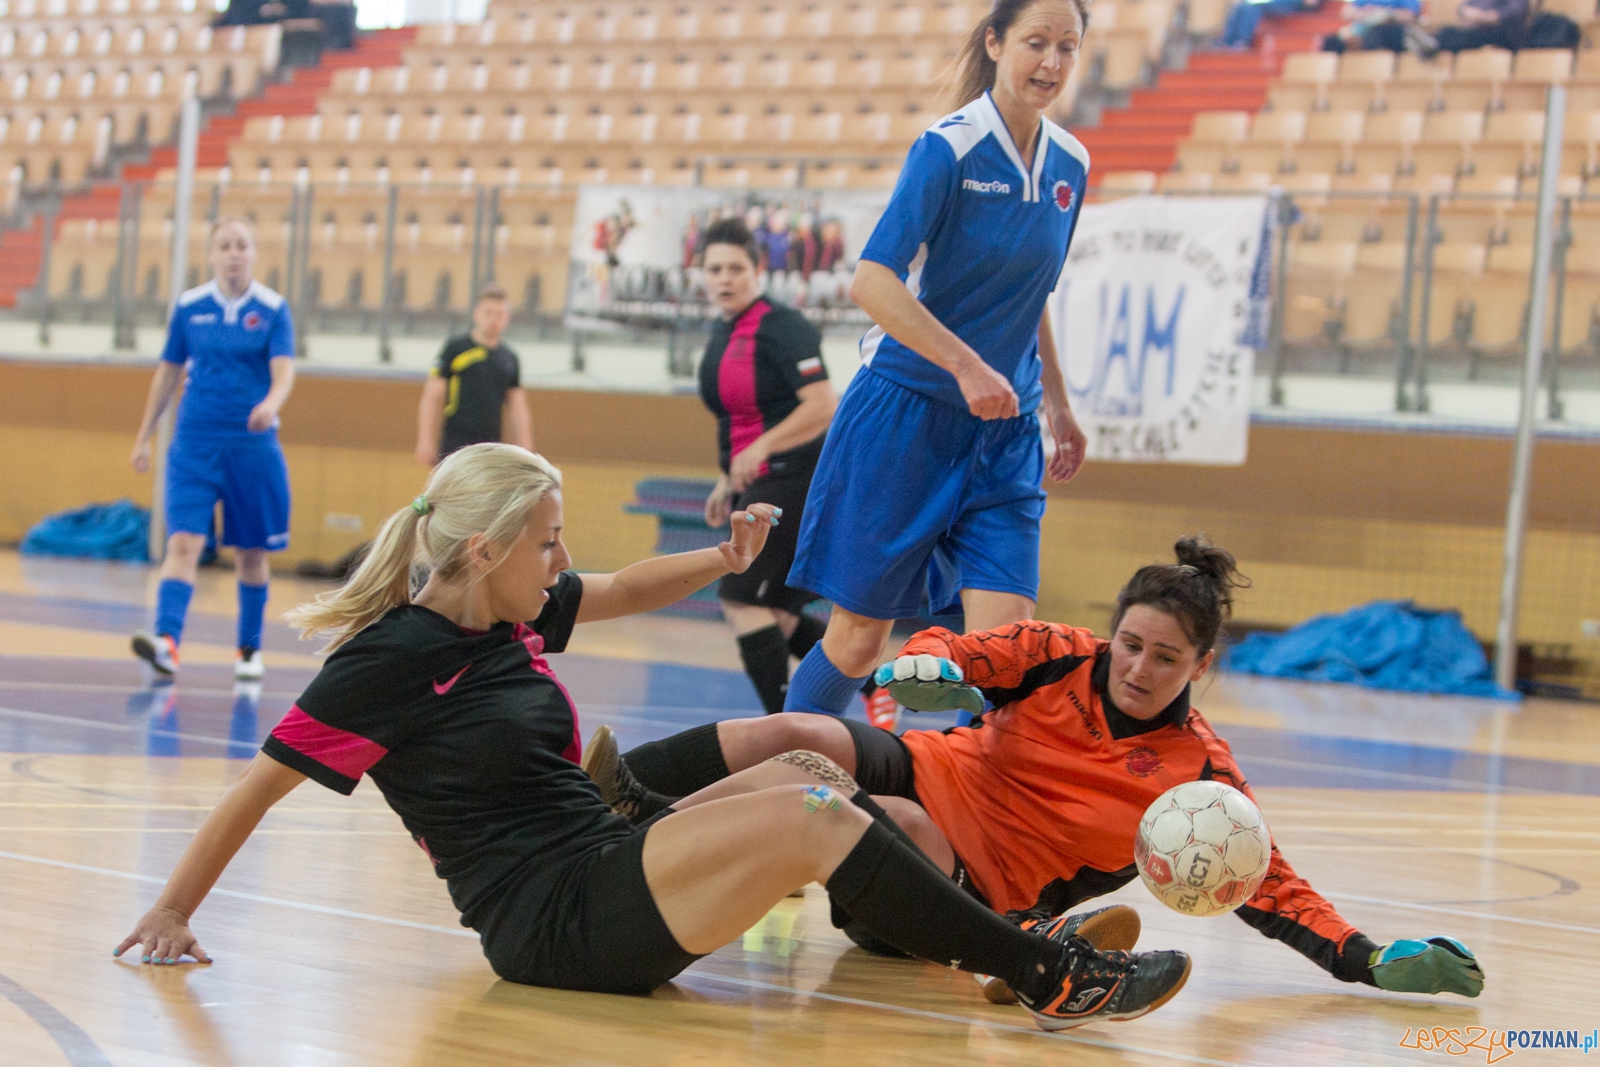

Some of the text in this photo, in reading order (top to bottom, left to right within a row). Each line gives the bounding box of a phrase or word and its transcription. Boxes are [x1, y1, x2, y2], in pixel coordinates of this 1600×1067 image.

[963, 179, 1010, 194] macron
[1057, 278, 1187, 397] UAM
[1176, 851, 1212, 913] SELECT
